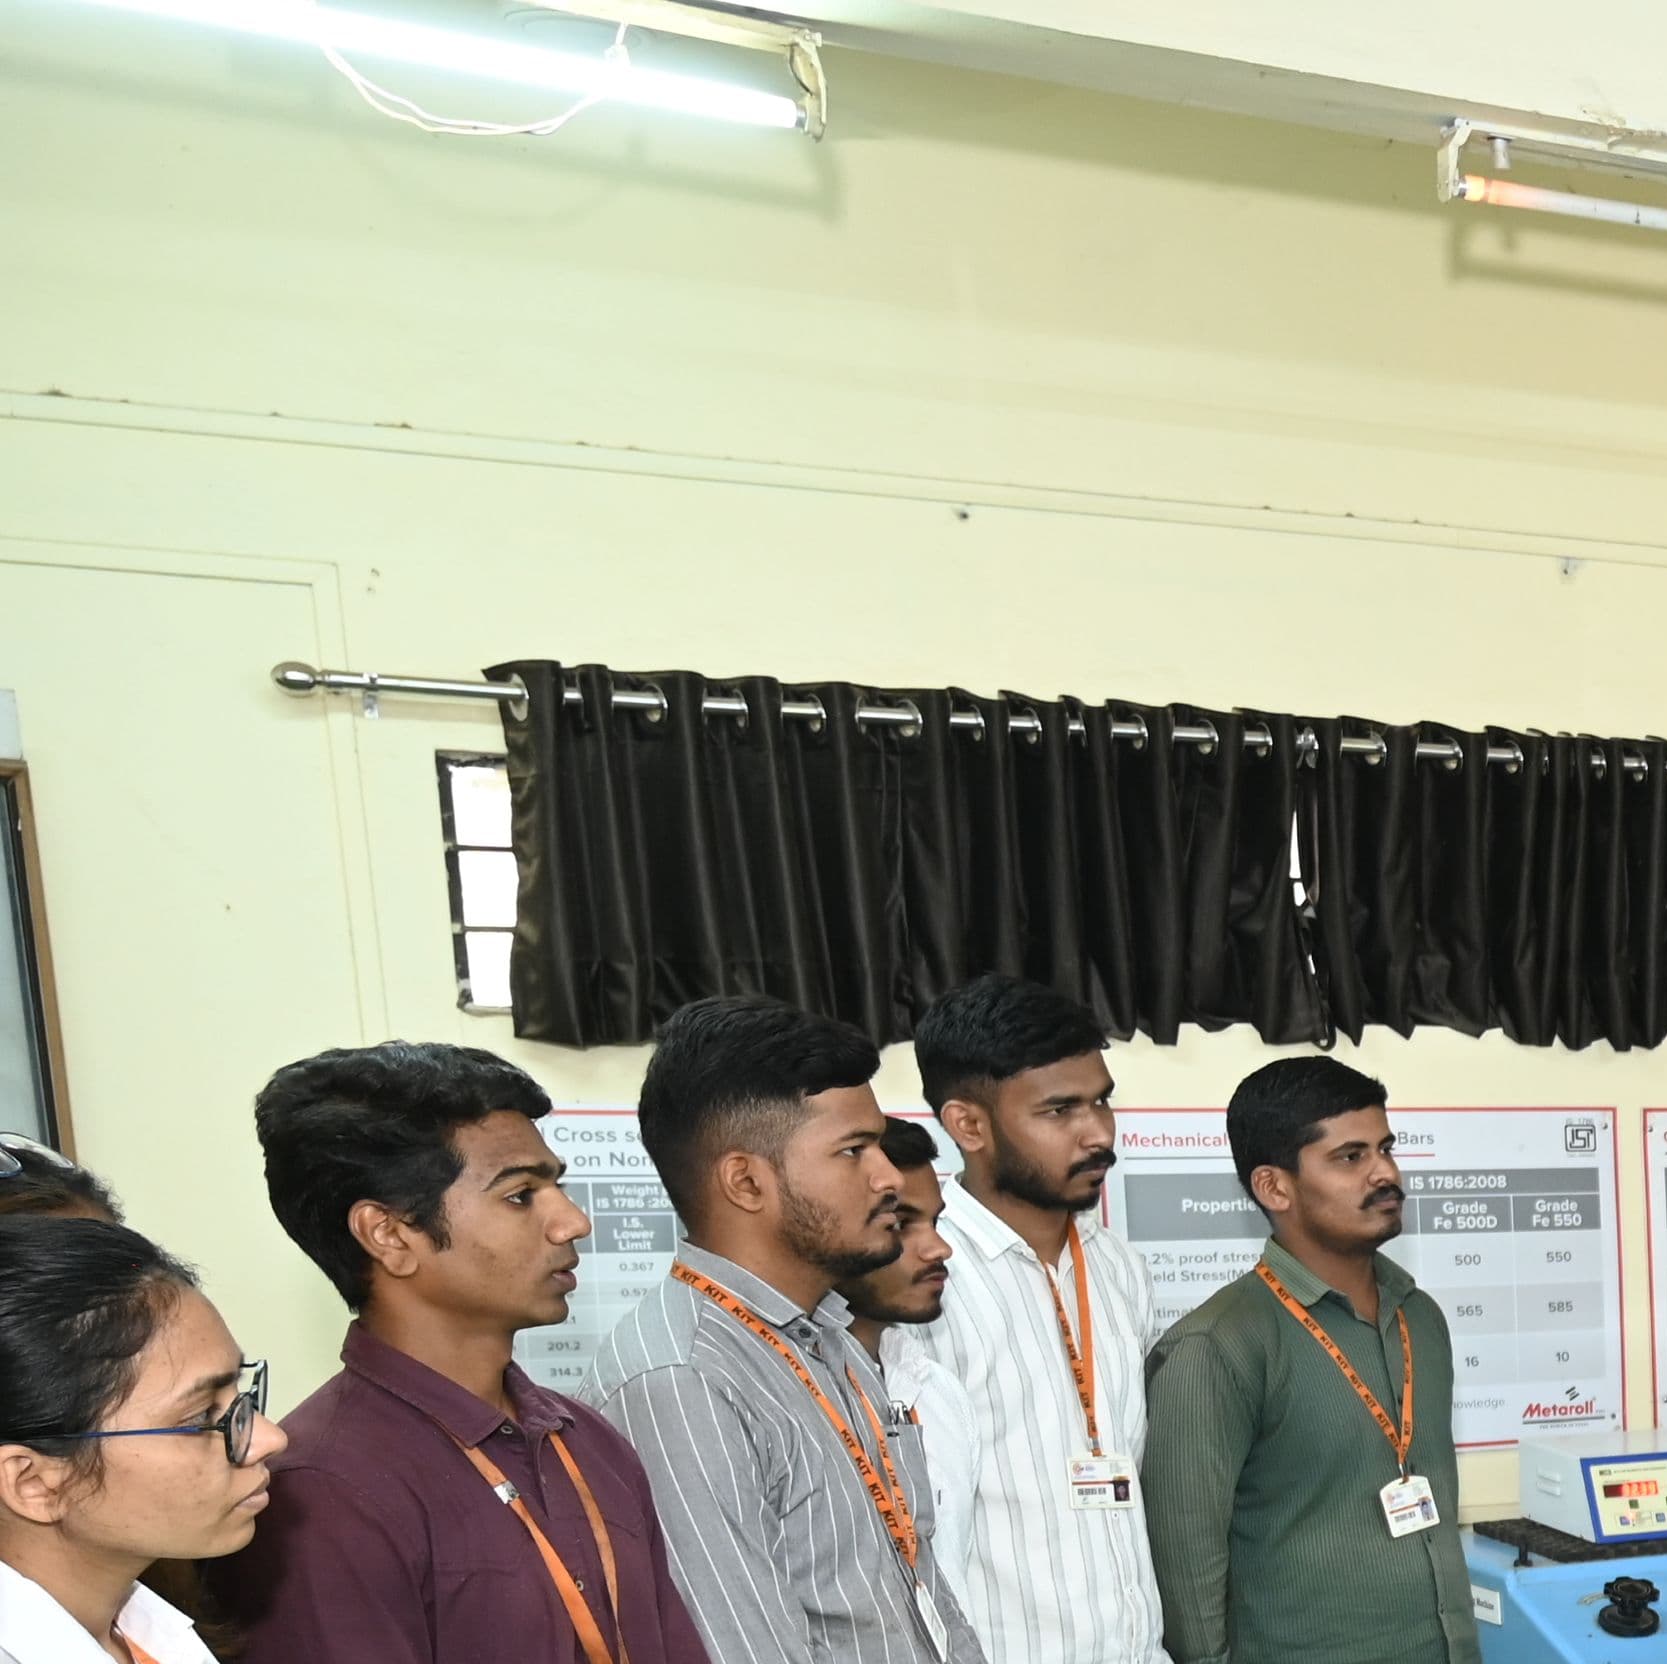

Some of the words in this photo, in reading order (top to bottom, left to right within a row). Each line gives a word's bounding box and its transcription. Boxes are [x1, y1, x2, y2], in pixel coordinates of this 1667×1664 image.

[554, 1126, 618, 1143] Cross
[1122, 1132, 1229, 1148] Mechanical
[1397, 1131, 1435, 1145] Bars
[573, 1155, 601, 1168] on
[1410, 1176, 1424, 1190] IS
[1428, 1175, 1508, 1190] 1786:2008
[611, 1184, 659, 1198] Weight
[1442, 1201, 1488, 1214] Grade
[1535, 1199, 1578, 1213] Grade
[1433, 1216, 1453, 1230] Fe
[1532, 1215, 1550, 1228] Fe
[1553, 1213, 1582, 1226] 550
[613, 1228, 655, 1240] Lower
[618, 1240, 652, 1251] Limit
[1179, 1252, 1218, 1267] proof
[1454, 1254, 1482, 1266] 500
[1546, 1251, 1572, 1263] 550
[547, 1341, 581, 1351] 201.2
[1522, 1399, 1594, 1418] Metaroll
